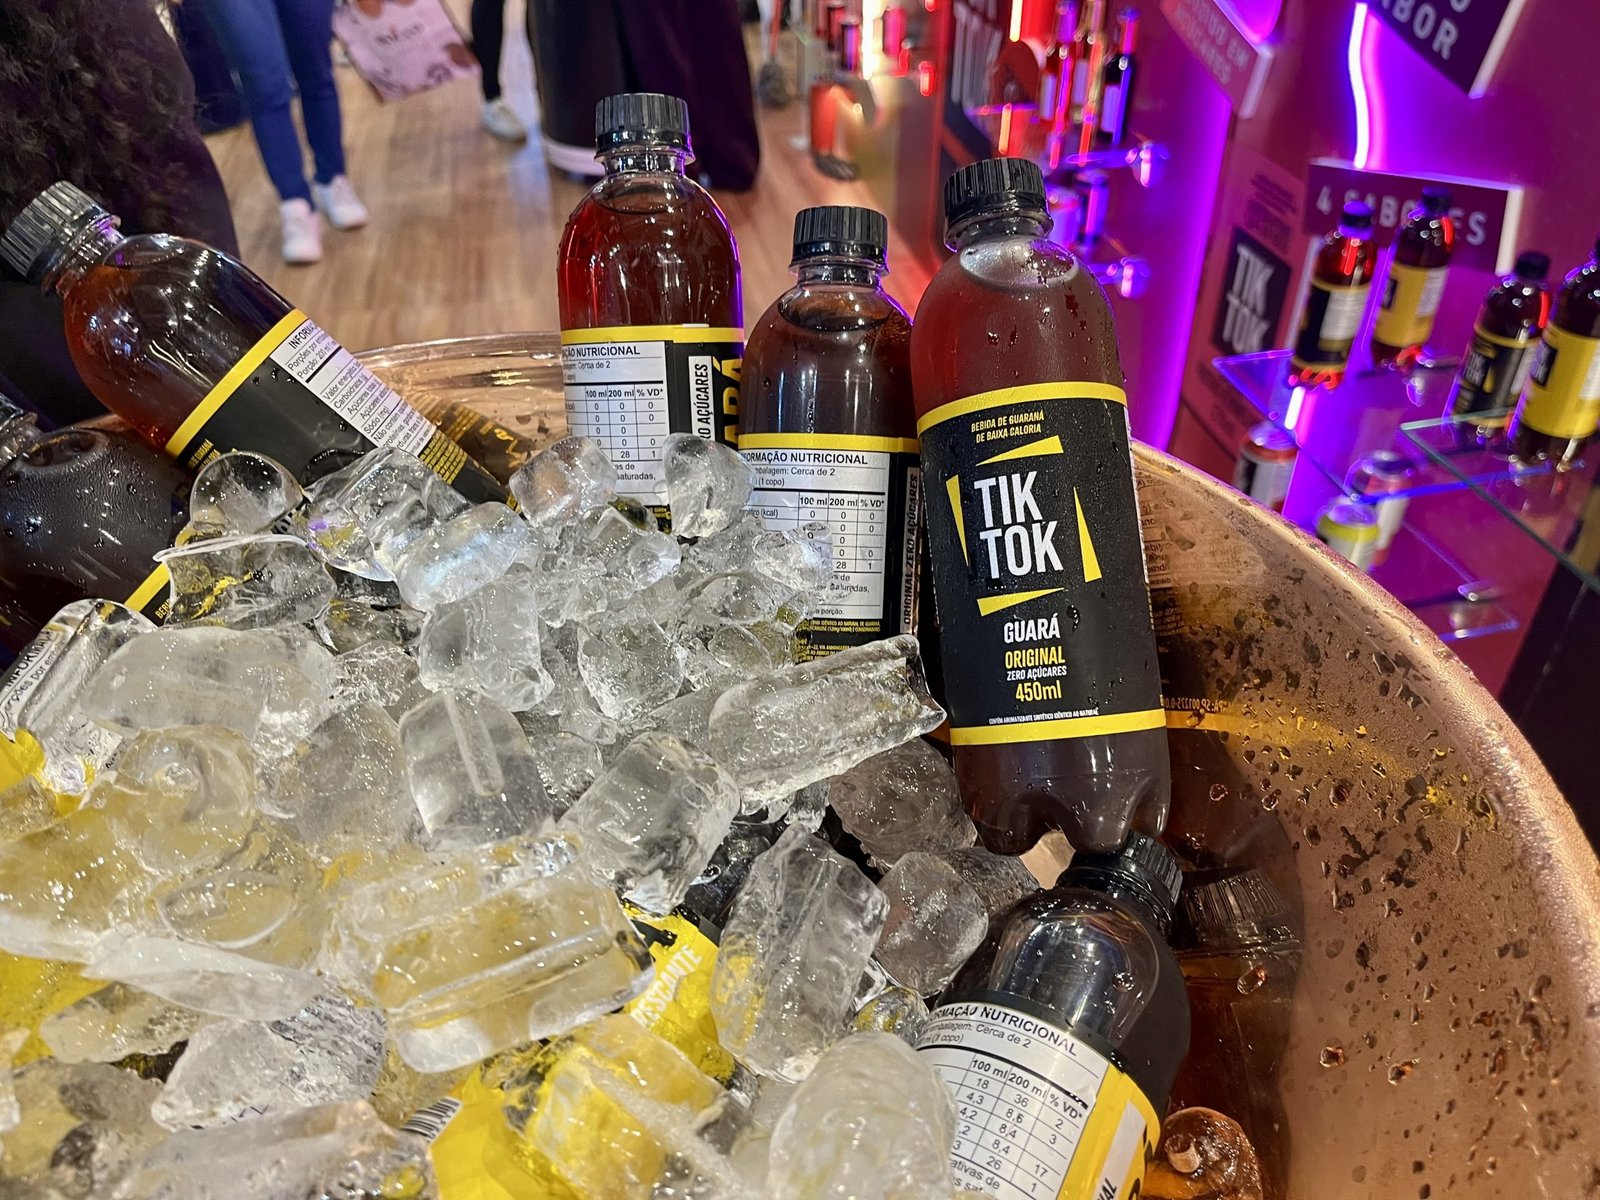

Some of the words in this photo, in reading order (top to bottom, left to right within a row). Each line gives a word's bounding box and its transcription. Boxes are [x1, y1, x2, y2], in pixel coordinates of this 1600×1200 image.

[1381, 0, 1459, 61] BOR
[1316, 184, 1333, 216] 4
[1236, 243, 1274, 318] TIK
[287, 347, 311, 371] Porções
[576, 345, 641, 357] NUTRICIONAL
[606, 361, 611, 369] 2
[323, 383, 340, 400] Valor
[586, 390, 597, 398] 100
[598, 389, 607, 398] ml
[608, 390, 622, 398] 200
[624, 389, 635, 397] ml
[637, 389, 645, 397] %
[693, 363, 714, 425] AÇÚCARES
[620, 402, 625, 410] 0
[648, 401, 654, 409] 0
[363, 417, 381, 434] Sódio
[620, 414, 625, 422] 0
[971, 418, 997, 433] BEBIDA
[997, 415, 1008, 427] DE
[373, 429, 386, 443] Não
[397, 429, 413, 449] rduras
[621, 426, 626, 434] 0
[976, 432, 986, 444] DE
[986, 428, 1009, 441] BAIXA
[1009, 423, 1042, 437] CALORIA
[650, 438, 656, 446] 0
[620, 450, 630, 458] 28
[790, 453, 869, 465] NUTRICIONAL
[791, 467, 815, 475] Cerca
[816, 467, 828, 476] de
[827, 468, 835, 476] 2
[765, 478, 785, 487] copo)
[800, 497, 815, 505] 100
[816, 497, 828, 505] ml
[829, 498, 845, 506] 200
[847, 498, 858, 507] ml
[860, 499, 868, 507] %
[906, 474, 918, 537] AÇÚCARES
[974, 470, 1044, 529] TIK
[840, 524, 846, 532] 0
[839, 549, 845, 557] 0
[905, 538, 916, 570] ZERO
[979, 520, 1064, 580] TOK
[903, 571, 914, 625] ORIGINAL
[1003, 612, 1061, 644] GUARÁ
[1005, 645, 1066, 669] ORIGINAL
[1006, 669, 1026, 681] ZERO
[1027, 665, 1068, 681] AÇÚCARES
[1015, 680, 1062, 702] 450ml
[631, 944, 702, 1027] RESCANTE
[976, 1023, 1005, 1039] Cerca
[1007, 1033, 1021, 1045] de
[1022, 1037, 1032, 1048] 2
[980, 1005, 1077, 1056] NUTRICIONAL
[972, 1059, 992, 1073] 100
[992, 1068, 1009, 1079] ml
[1008, 1073, 1030, 1089] 200
[1031, 1085, 1048, 1098] ml
[1050, 1093, 1059, 1107] %
[976, 1078, 990, 1090] 18
[1013, 1094, 1030, 1108] 36
[1055, 1119, 1064, 1129] 2
[959, 1107, 978, 1120] 4,2
[998, 1123, 1018, 1139] 8,4
[966, 1092, 985, 1105] 4,3
[1005, 1108, 1024, 1124] 8,6
[1048, 1134, 1057, 1145] 3
[952, 1140, 962, 1151] 3
[986, 1155, 1002, 1171] 26
[1031, 1183, 1038, 1193] 1
[991, 1139, 1011, 1155] 8,4
[1034, 1164, 1048, 1178] 17
[985, 1177, 1000, 1190] de
